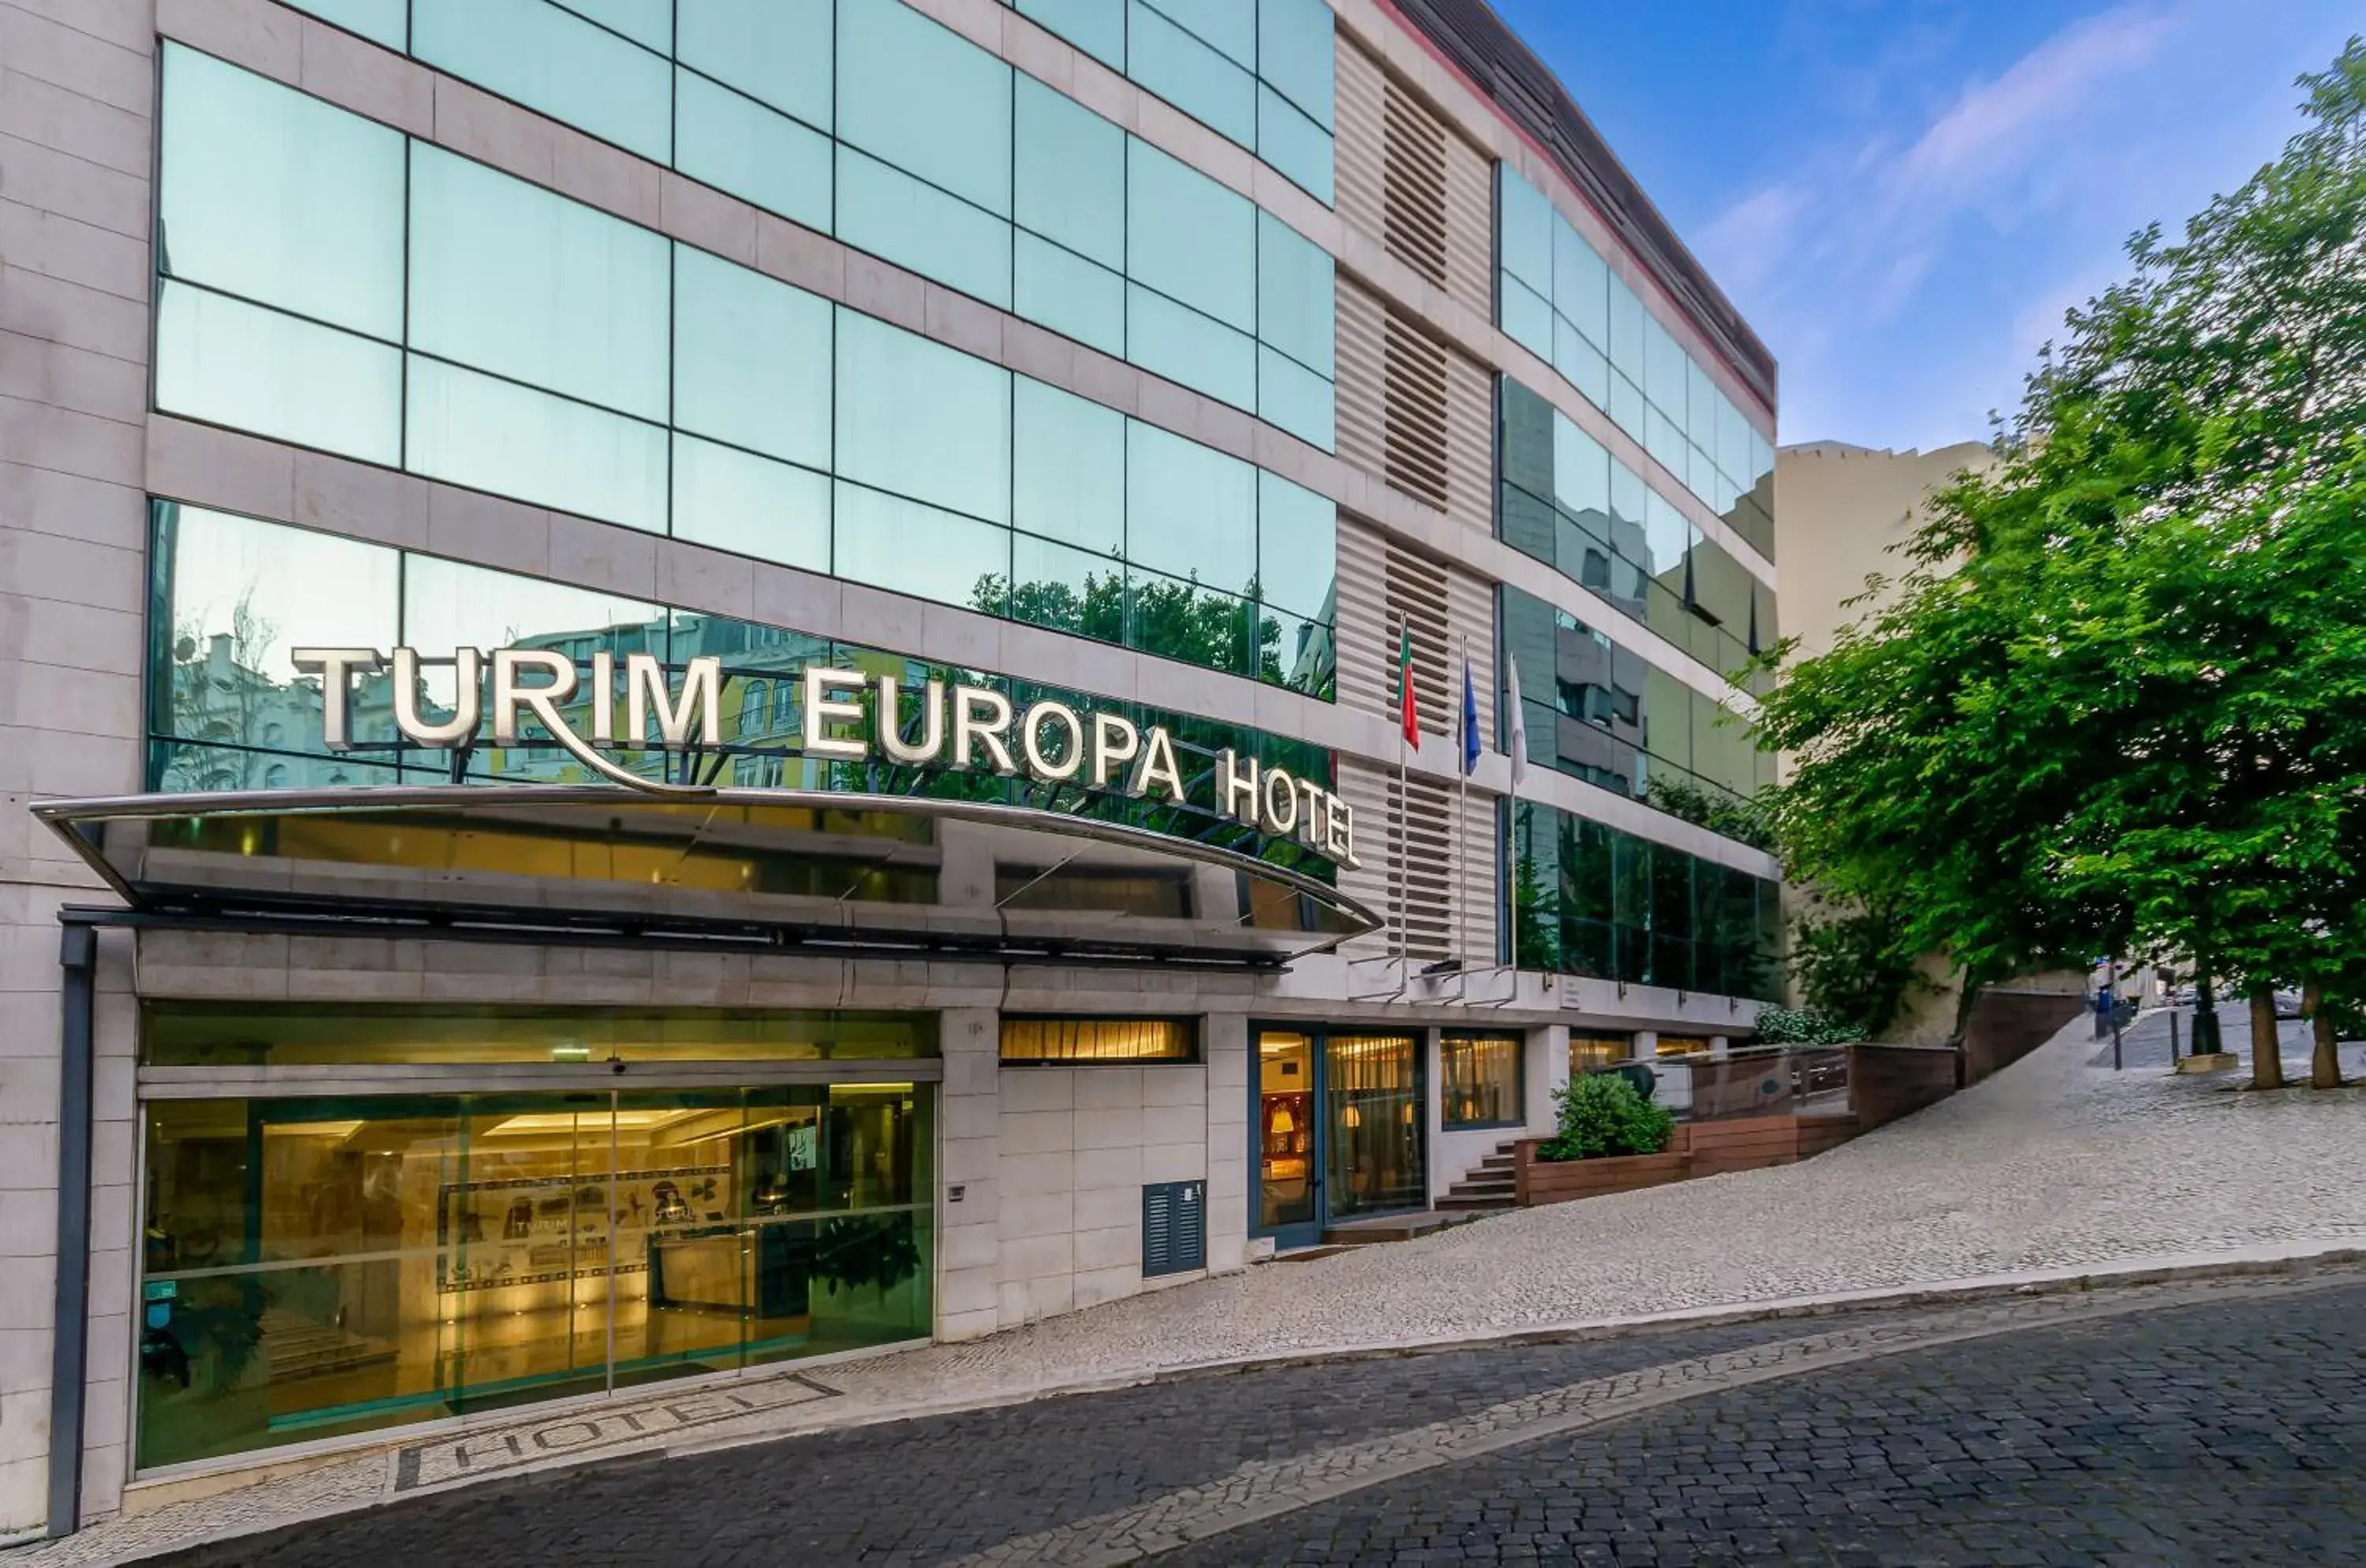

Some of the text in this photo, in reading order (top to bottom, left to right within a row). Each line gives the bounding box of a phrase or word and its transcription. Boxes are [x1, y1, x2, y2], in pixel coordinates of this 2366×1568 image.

[291, 647, 1362, 869] TURIM EUROPA HOTEL
[455, 1394, 793, 1467] HOTEL
